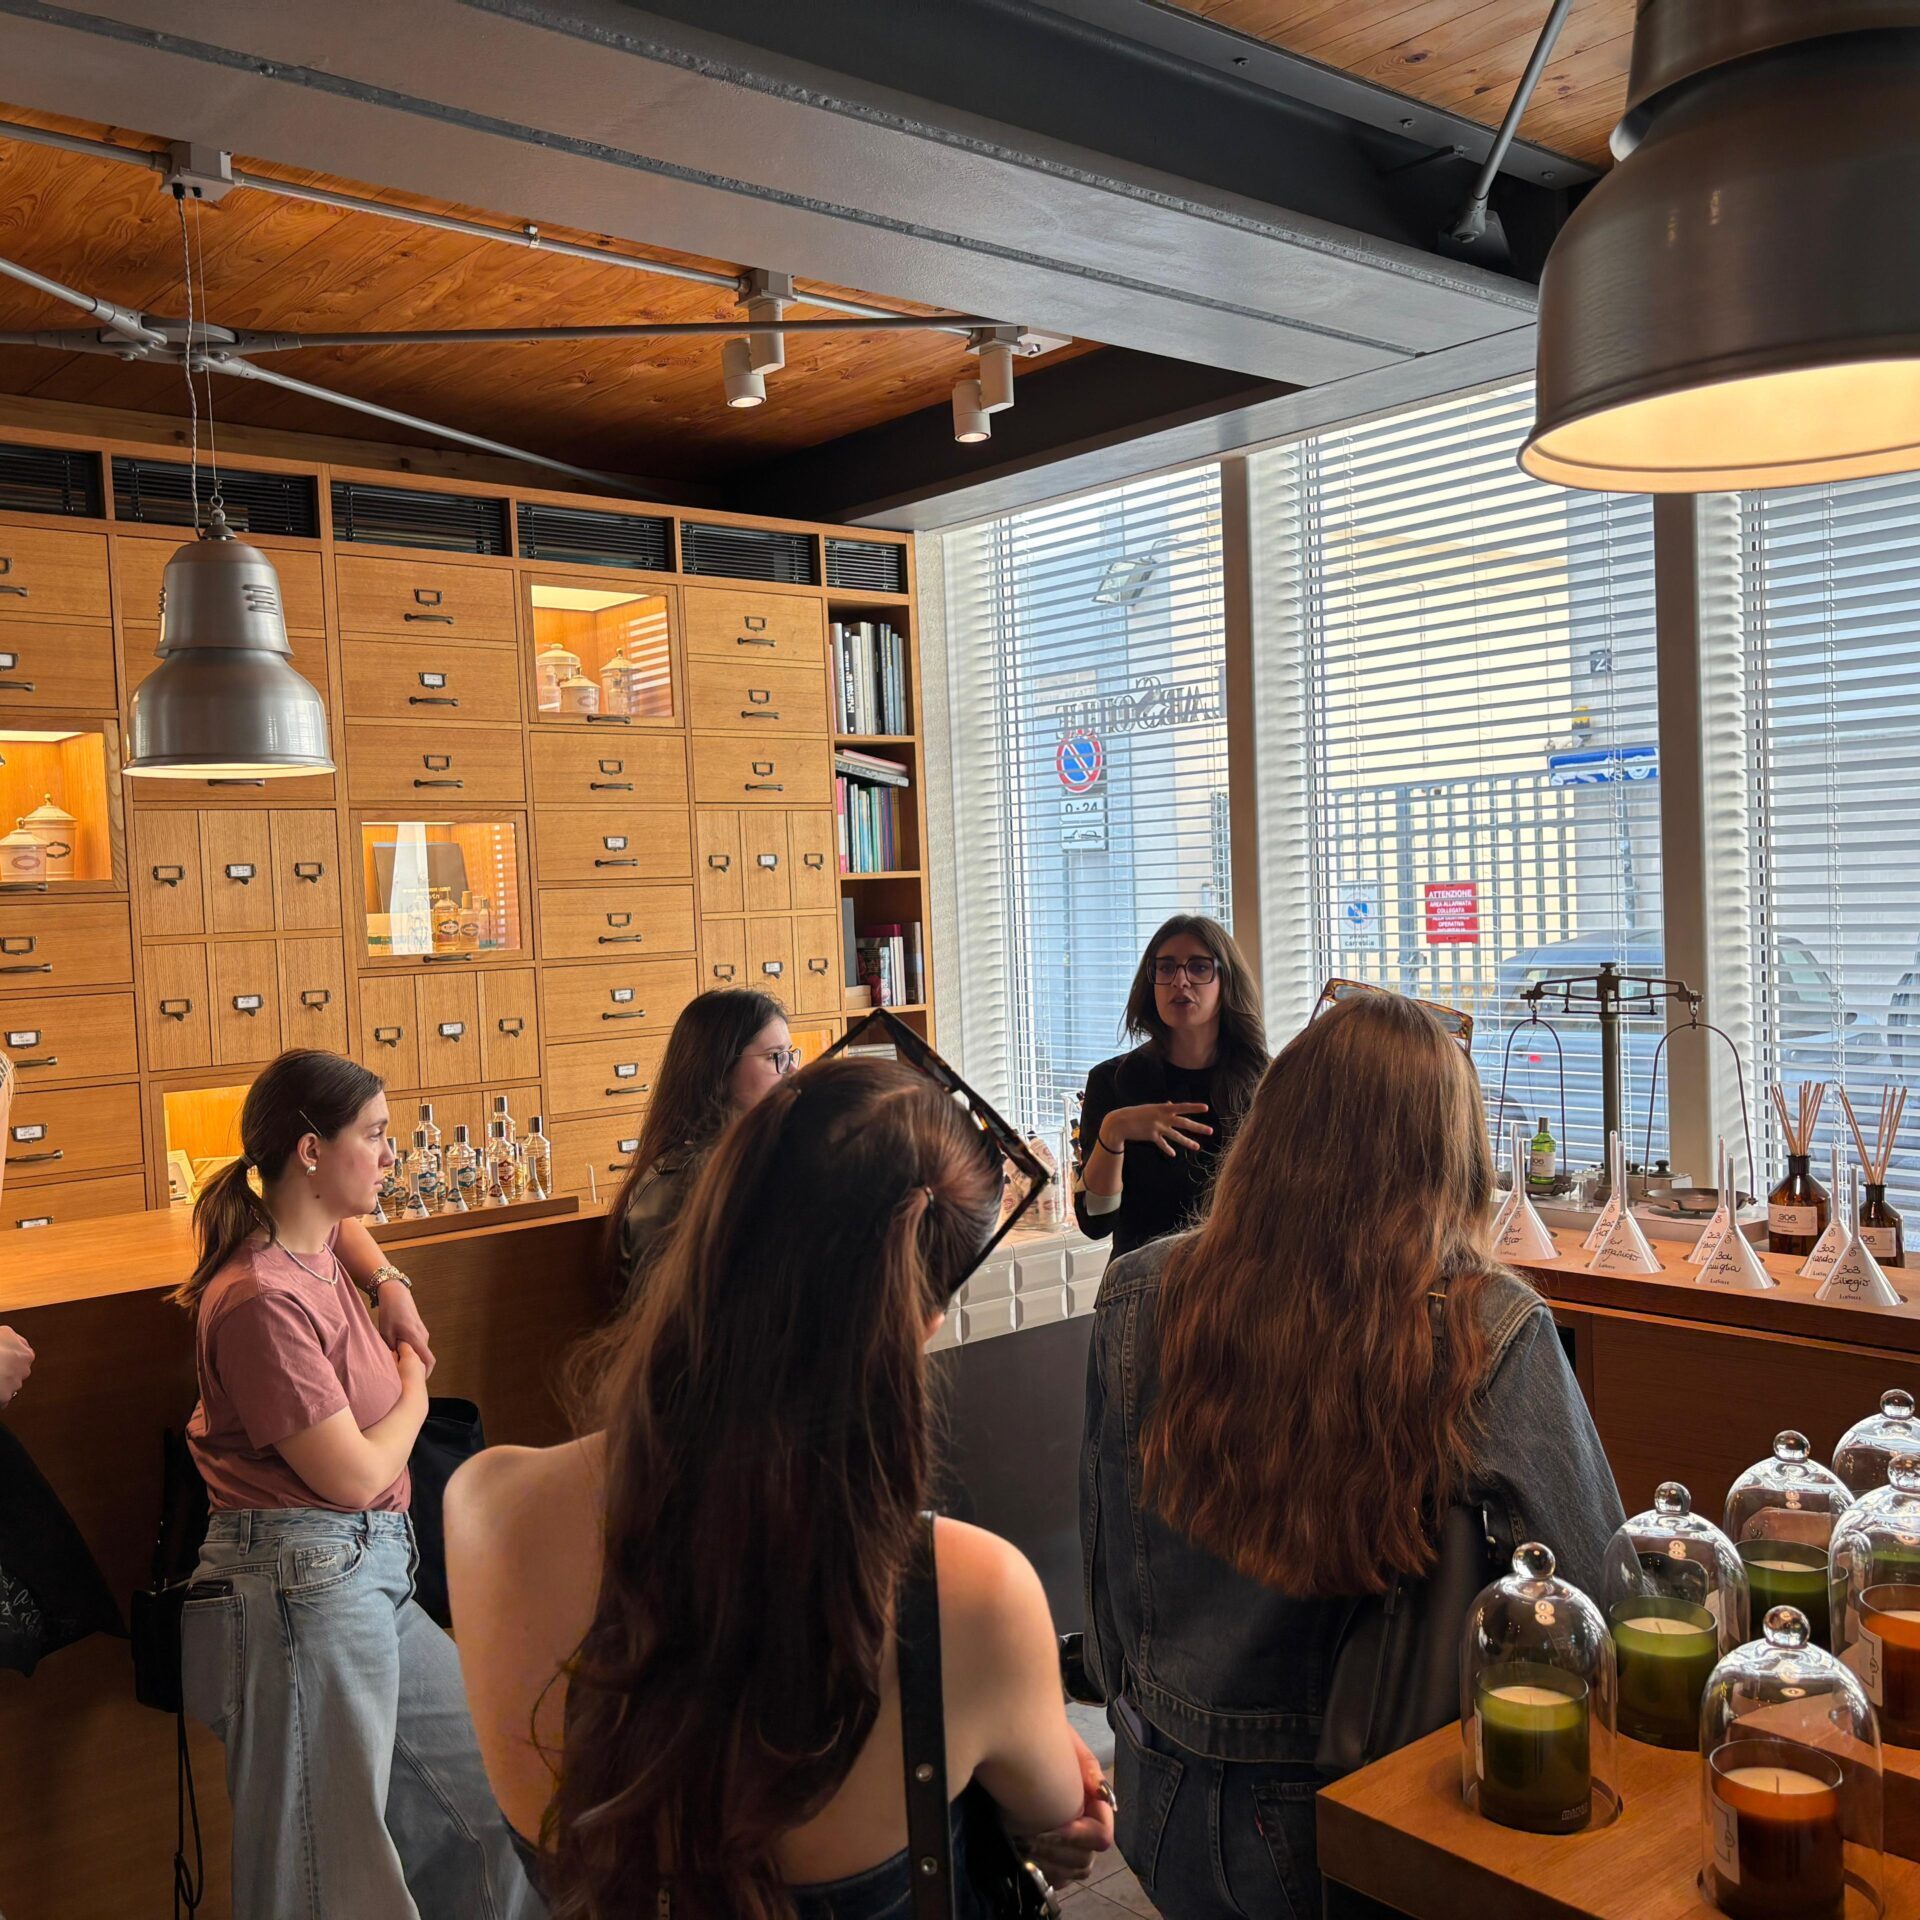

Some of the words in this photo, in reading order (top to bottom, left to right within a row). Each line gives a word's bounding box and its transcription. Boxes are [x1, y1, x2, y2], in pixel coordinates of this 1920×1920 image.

[1428, 889, 1473, 899] ATTENZIONE
[1817, 1243, 1836, 1254] 302
[1839, 1264, 1861, 1275] 303
